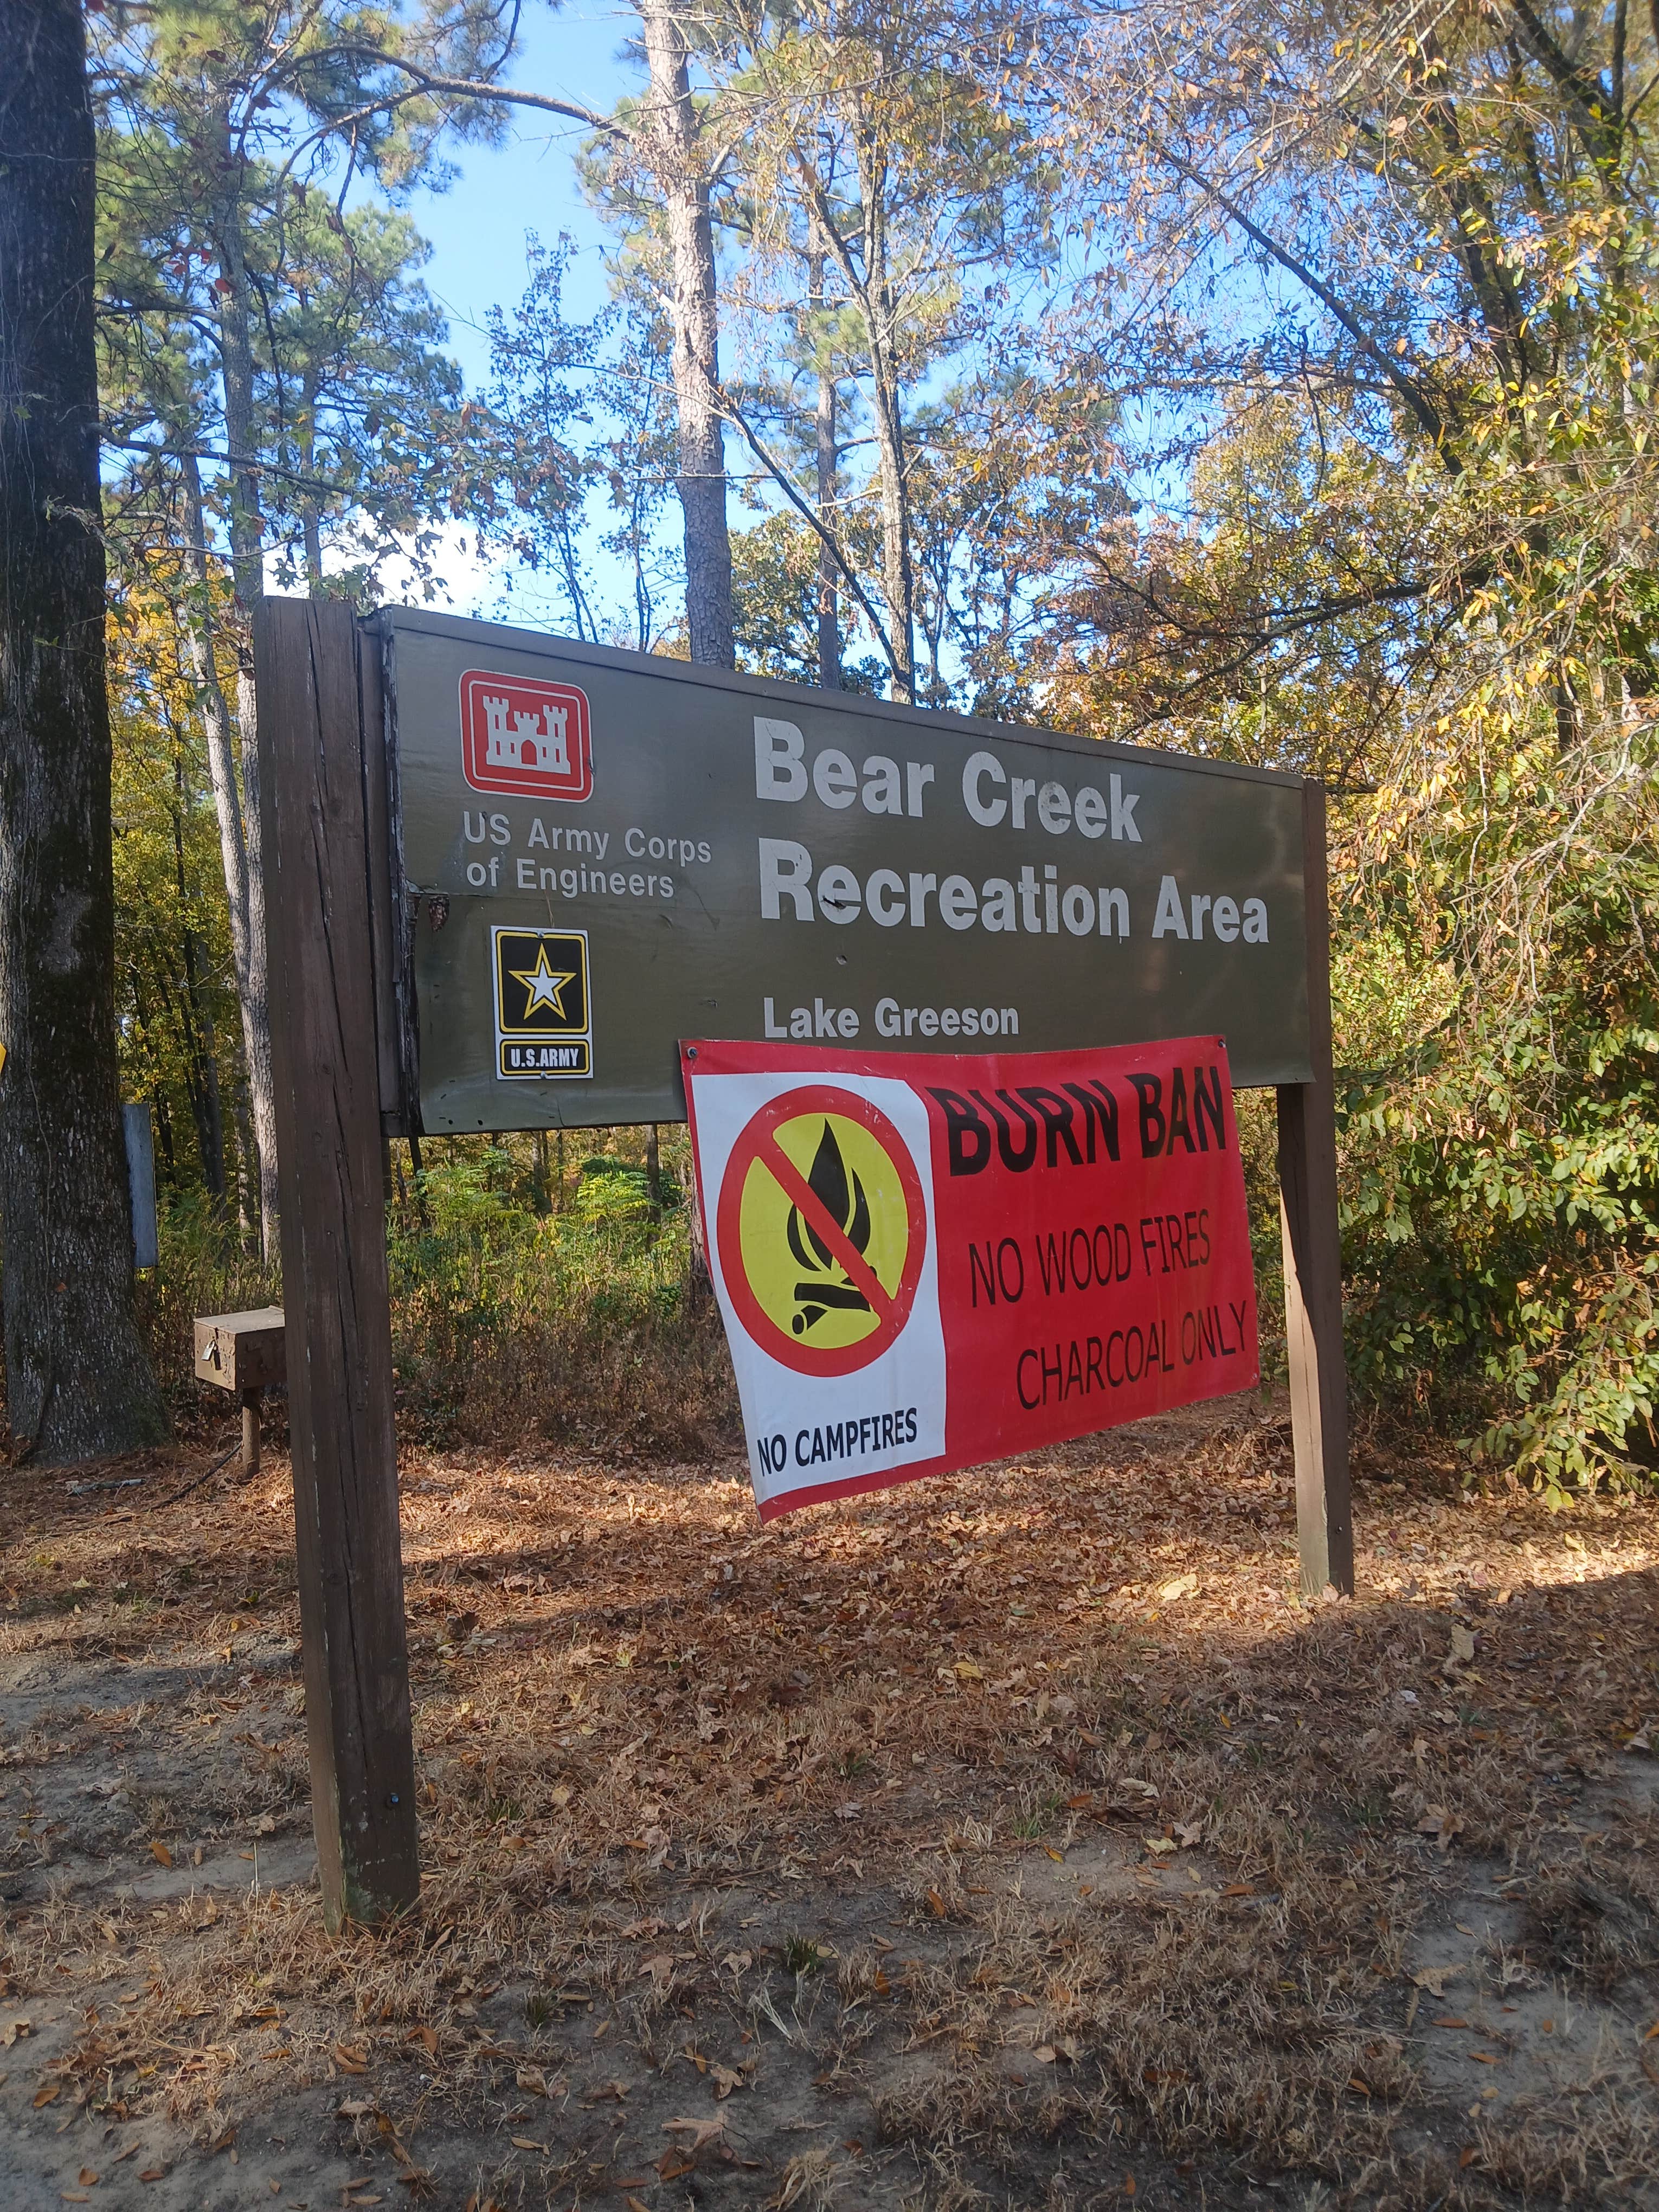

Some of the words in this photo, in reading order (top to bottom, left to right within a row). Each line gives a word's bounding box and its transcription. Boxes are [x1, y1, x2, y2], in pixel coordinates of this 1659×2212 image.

[754, 716, 935, 818] Bear
[962, 751, 1142, 843] Creek
[464, 811, 511, 846] US
[528, 818, 609, 860] Army
[625, 827, 712, 867] Corps
[466, 858, 499, 888] of
[518, 859, 674, 899] Engineers
[760, 838, 1130, 937] Recreation
[1152, 875, 1269, 944] Area
[764, 997, 859, 1039] Lake
[874, 997, 1019, 1037] Greeson
[926, 1079, 1120, 1177] BURN
[1125, 1066, 1226, 1158] BAN
[969, 1237, 1023, 1308] NO
[1036, 1223, 1130, 1294] WOOD
[1140, 1209, 1210, 1276] FIRES
[1017, 1320, 1173, 1410] CHARCOAL
[1181, 1301, 1246, 1365] ONLY
[757, 1438, 787, 1476] NO
[795, 1407, 917, 1465] CAMPFIRES
